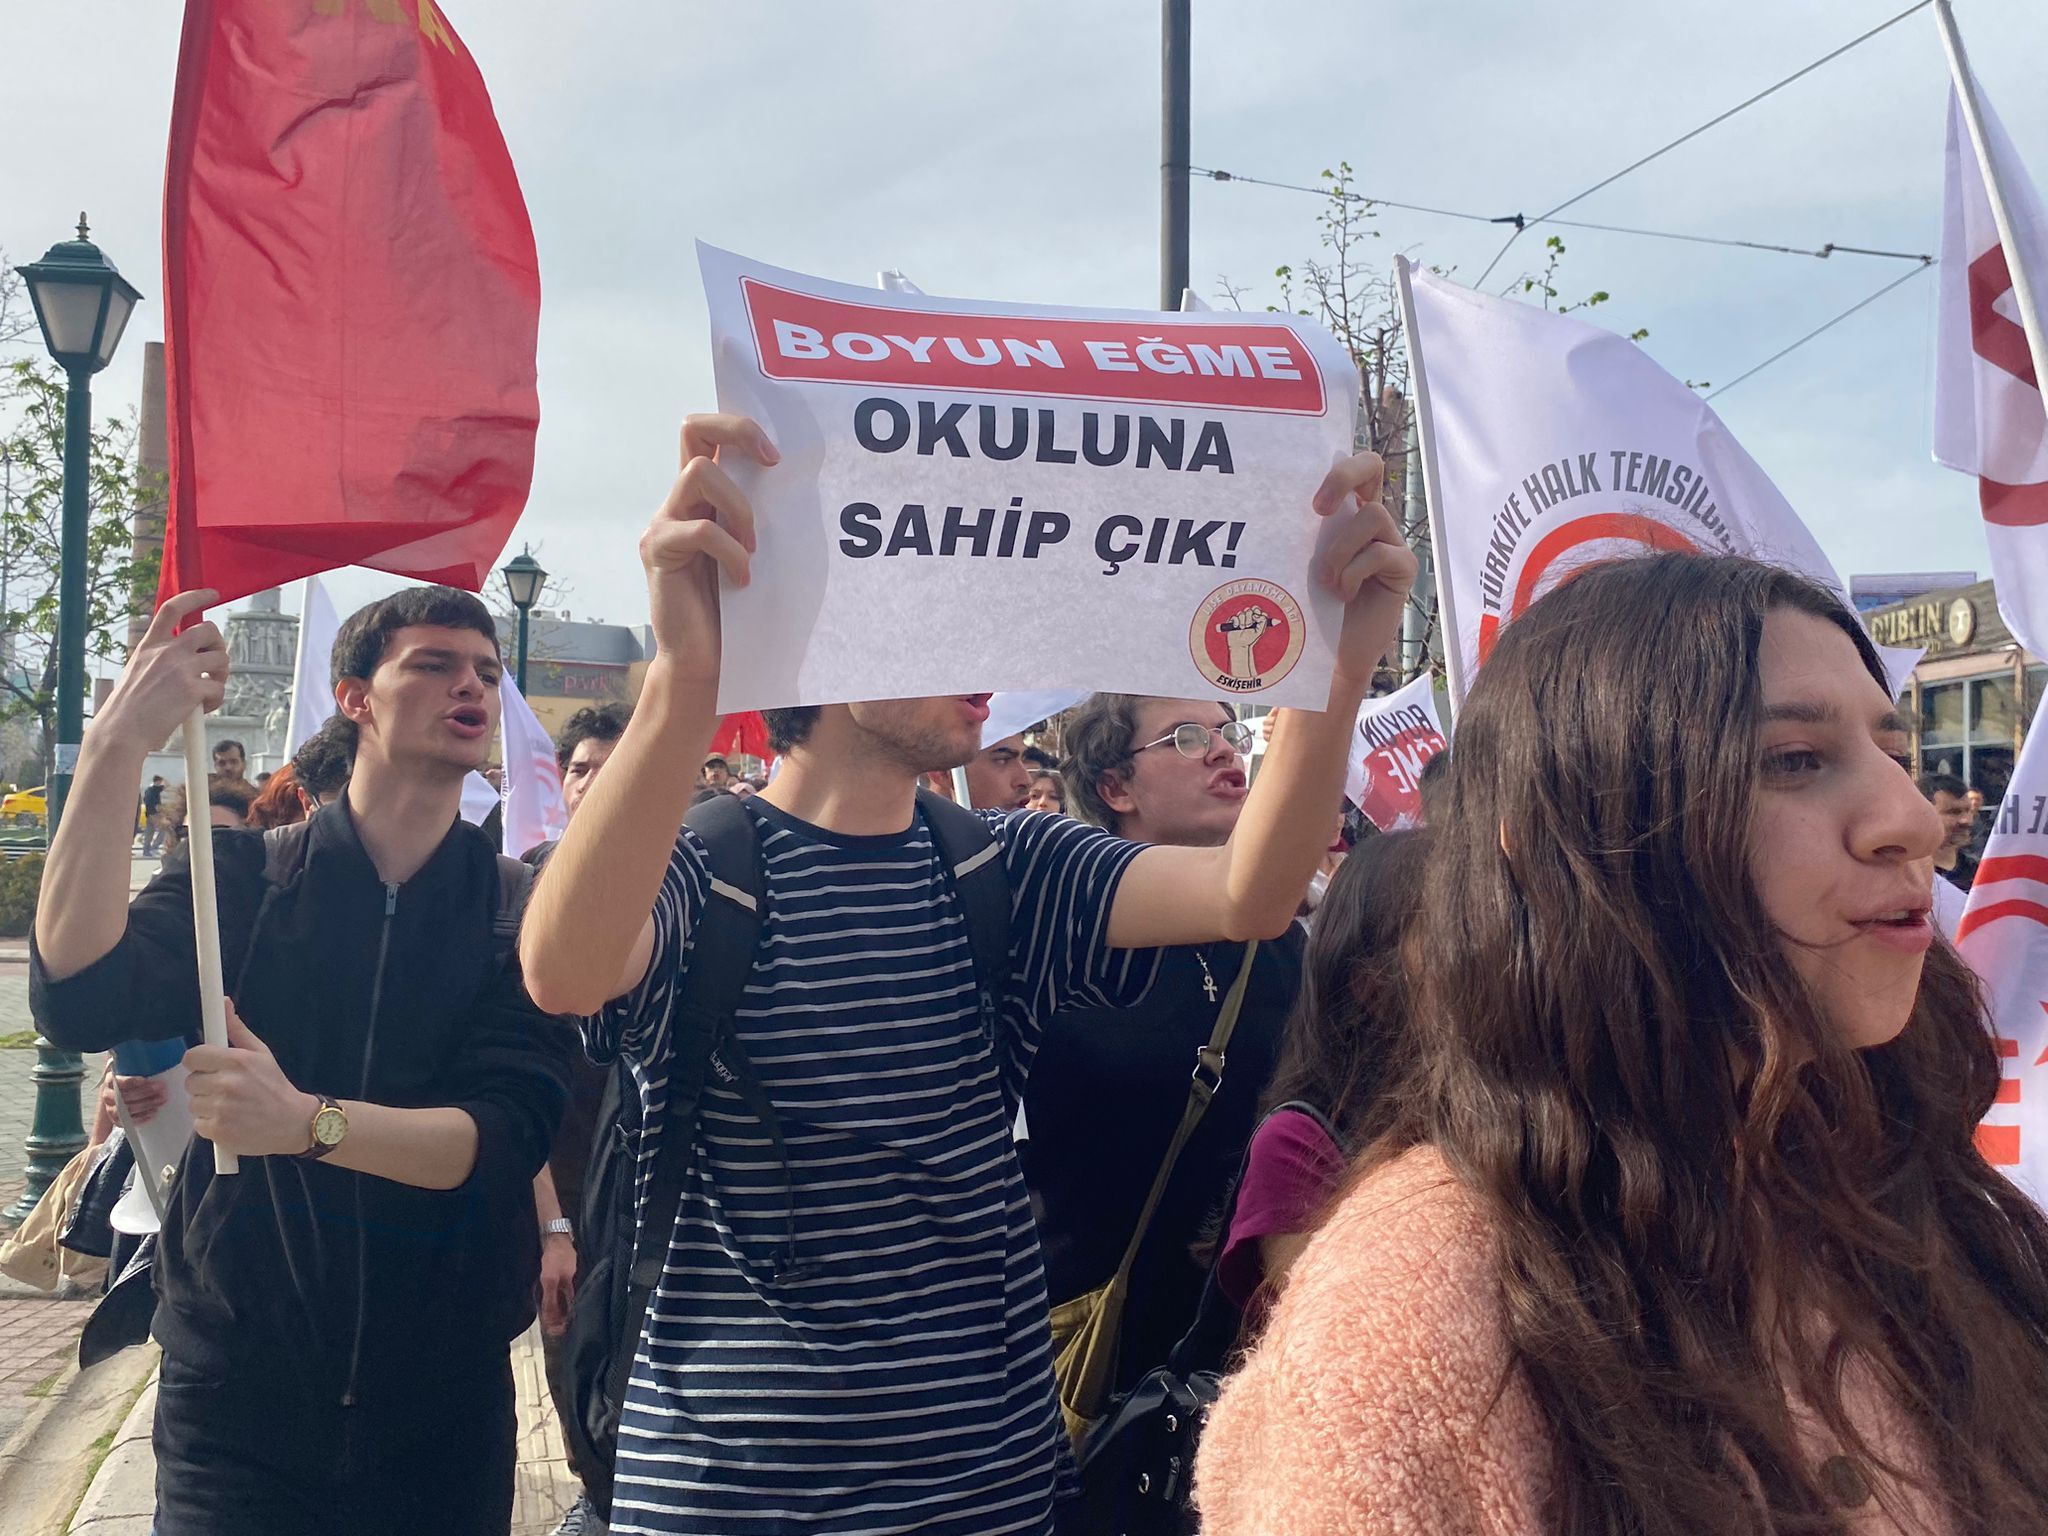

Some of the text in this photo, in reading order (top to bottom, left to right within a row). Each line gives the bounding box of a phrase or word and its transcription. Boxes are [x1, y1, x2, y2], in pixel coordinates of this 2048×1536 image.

[771, 318, 1303, 382] BOYUN EĞME
[853, 397, 1235, 475] OKULUNA
[838, 496, 1247, 577] SAHİP ÇIK!
[1479, 491, 1532, 611] TÜRKİYE
[1521, 452, 1602, 516] HALK
[1871, 602, 1940, 644] DUBLIN
[1216, 675, 1262, 690] ESKİŞEHİR
